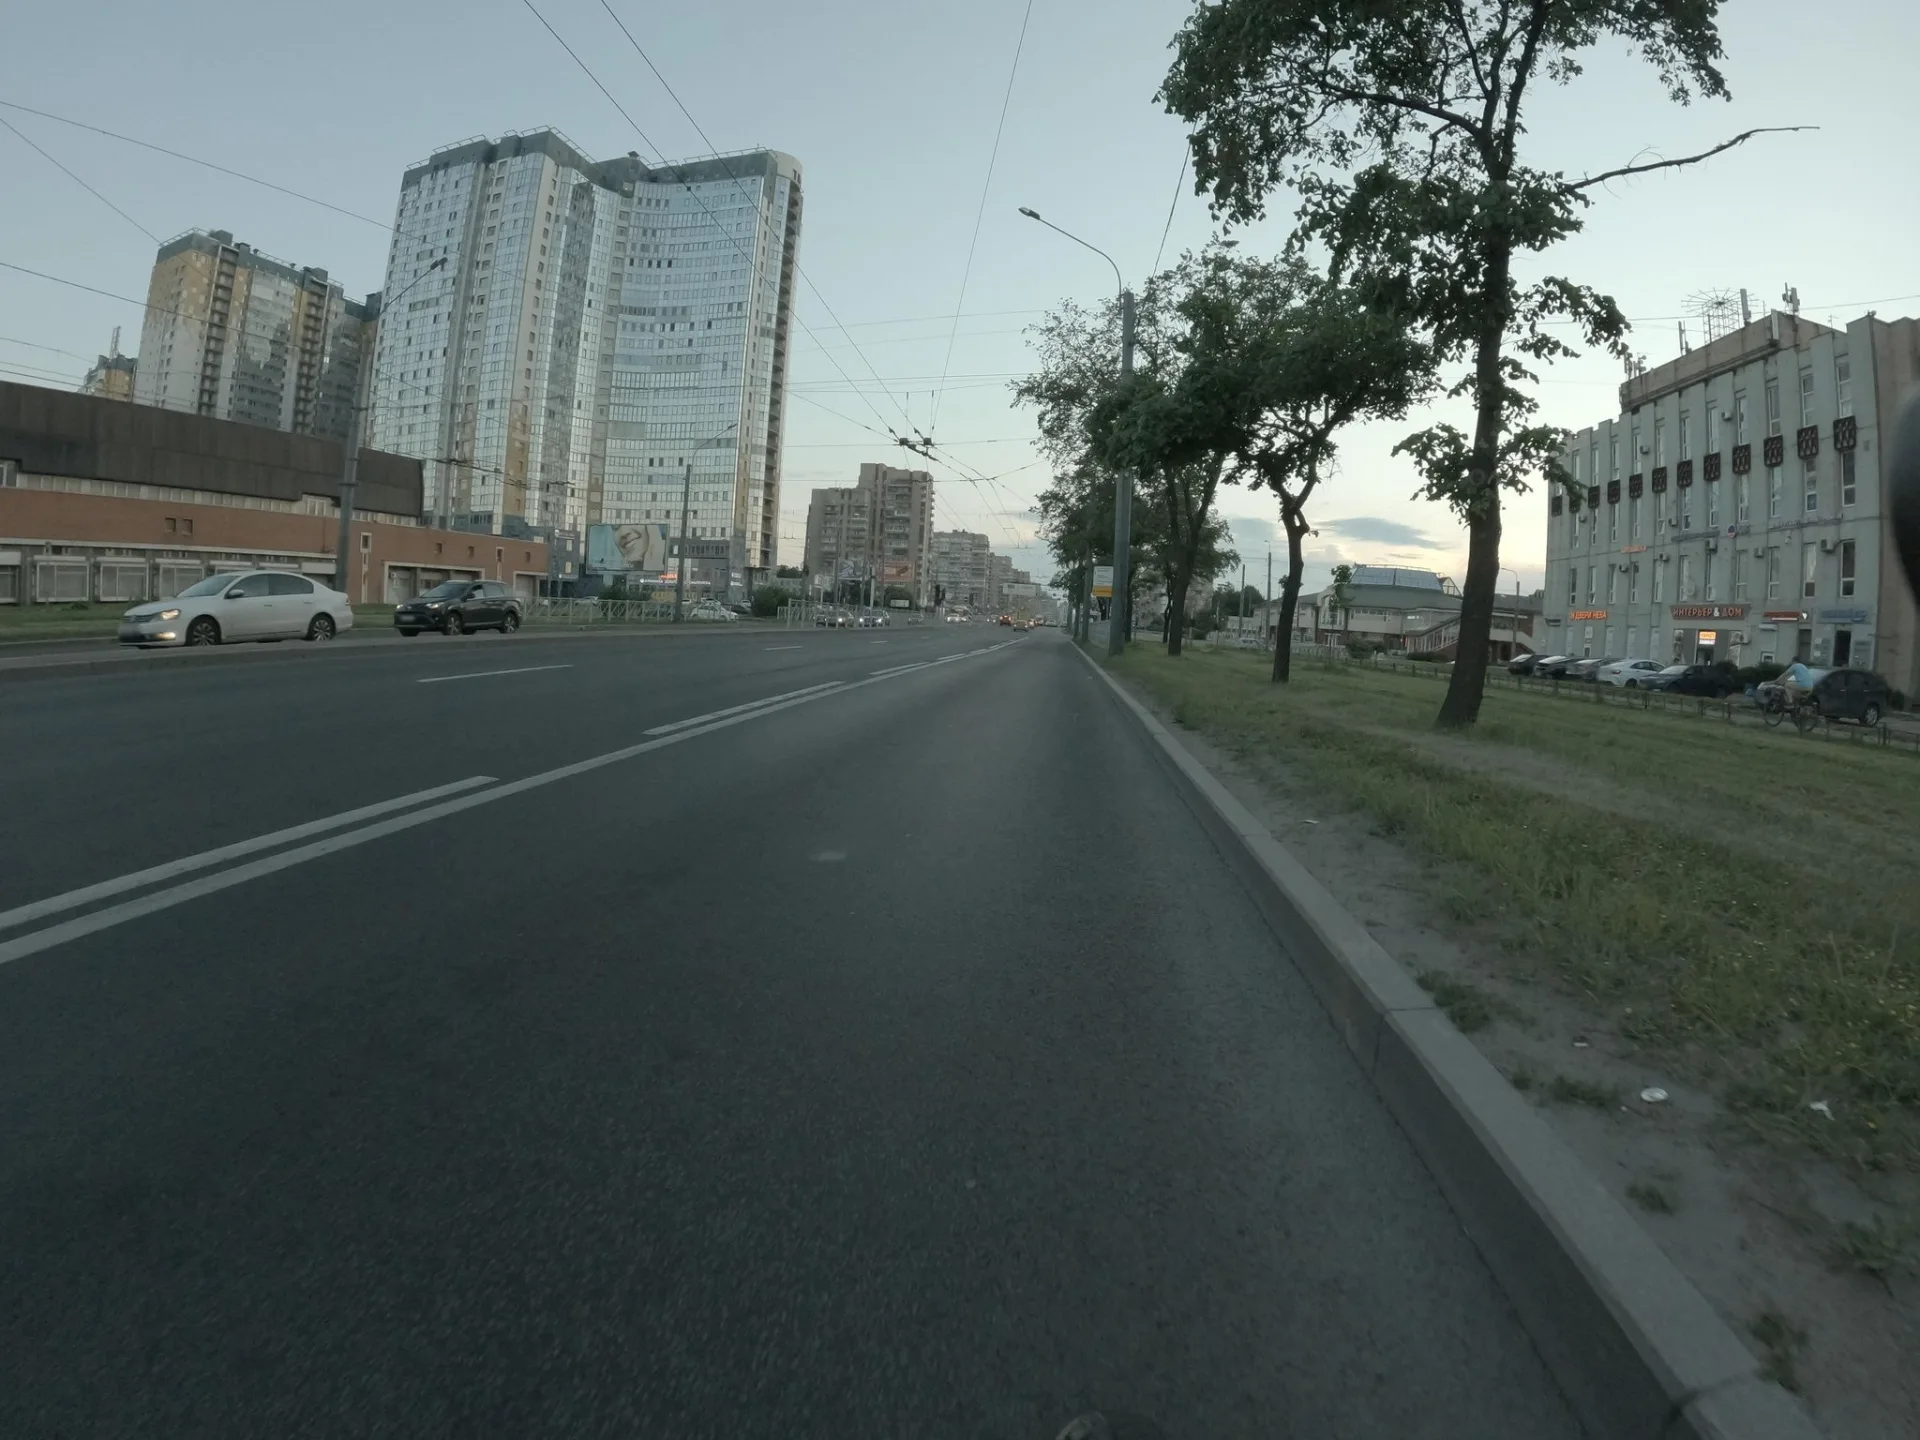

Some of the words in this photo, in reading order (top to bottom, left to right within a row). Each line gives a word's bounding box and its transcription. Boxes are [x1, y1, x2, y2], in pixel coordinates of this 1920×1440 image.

[1673, 607, 1712, 617] ИНТЕРЬЕР
[1713, 606, 1720, 617] &
[1721, 607, 1742, 617] ДОМ
